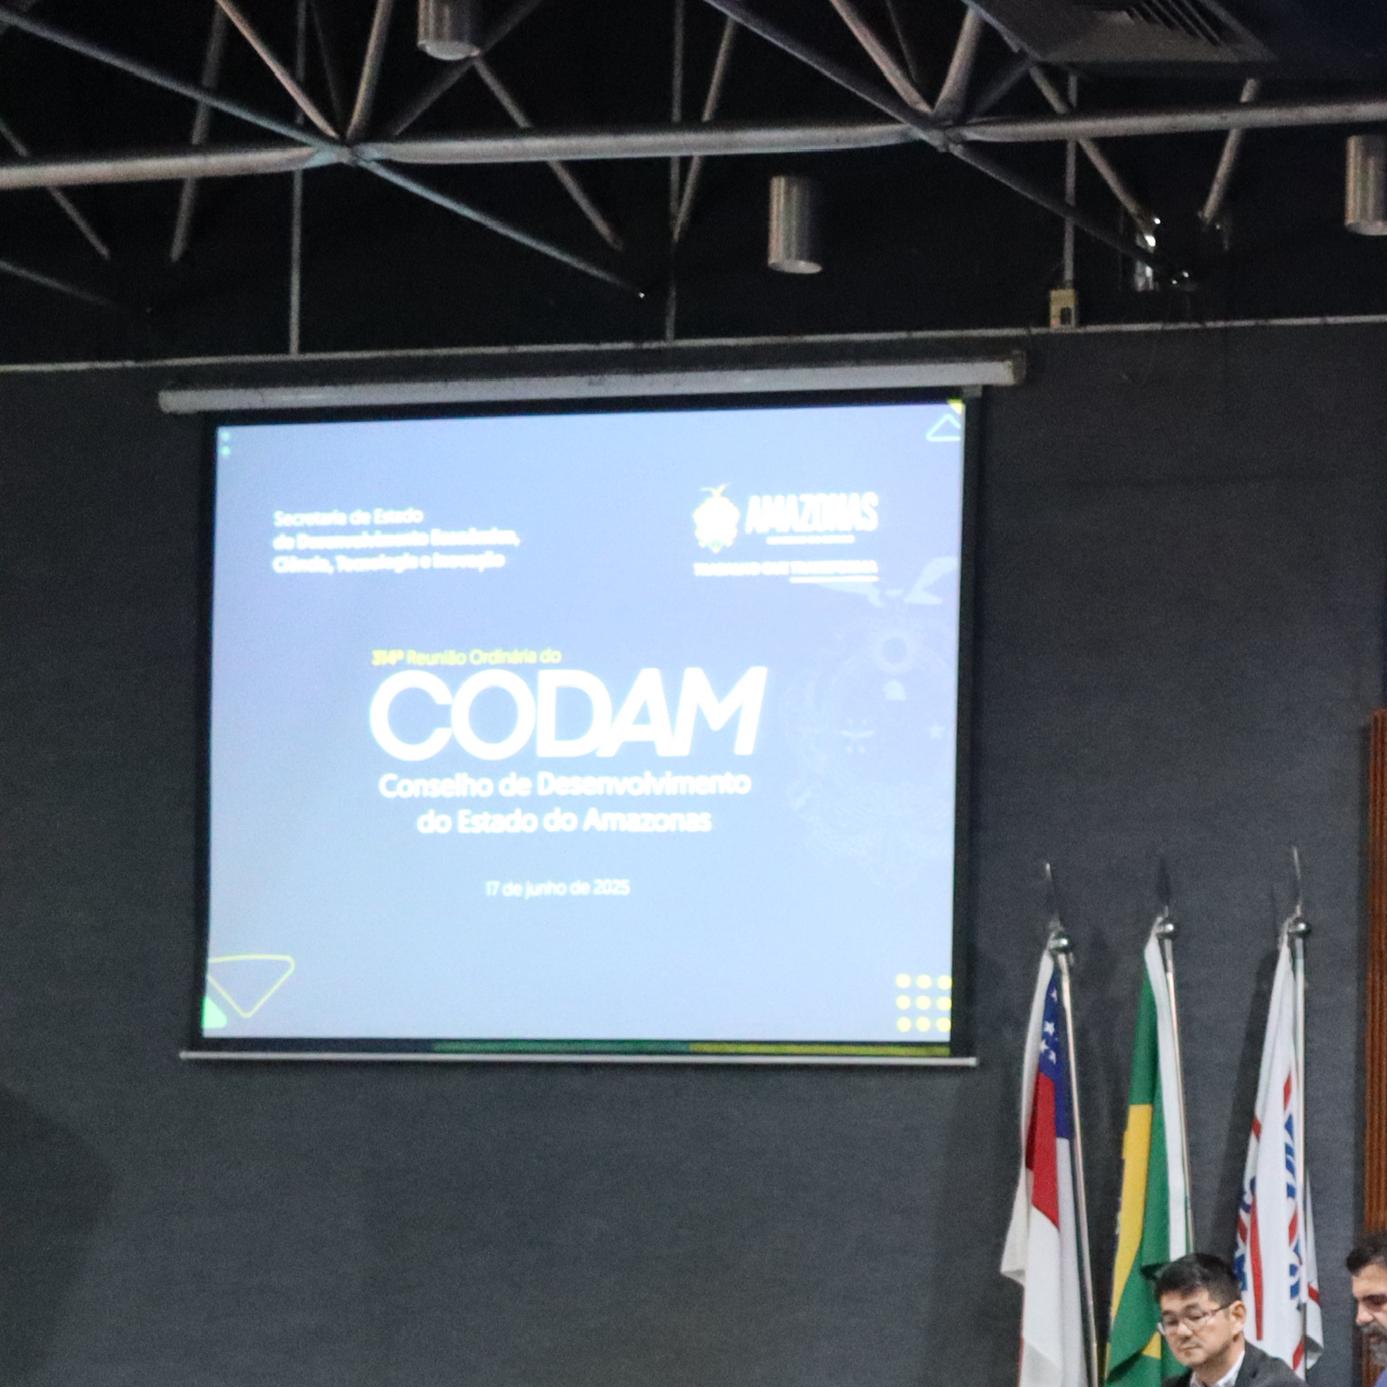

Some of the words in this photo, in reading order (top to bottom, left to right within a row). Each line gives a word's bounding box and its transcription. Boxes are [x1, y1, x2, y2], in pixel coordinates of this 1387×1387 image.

[539, 647, 562, 665] do
[369, 665, 768, 761] CODAM
[378, 772, 494, 798] Conselho
[499, 771, 532, 797] de
[537, 769, 752, 796] Desenvolvimento
[416, 809, 452, 834] do
[457, 808, 538, 834] Estado
[543, 807, 578, 832] do
[583, 807, 712, 832] Amazonas
[485, 880, 501, 897] 17
[501, 880, 523, 898] de
[524, 879, 567, 900] junho
[569, 880, 591, 898] de
